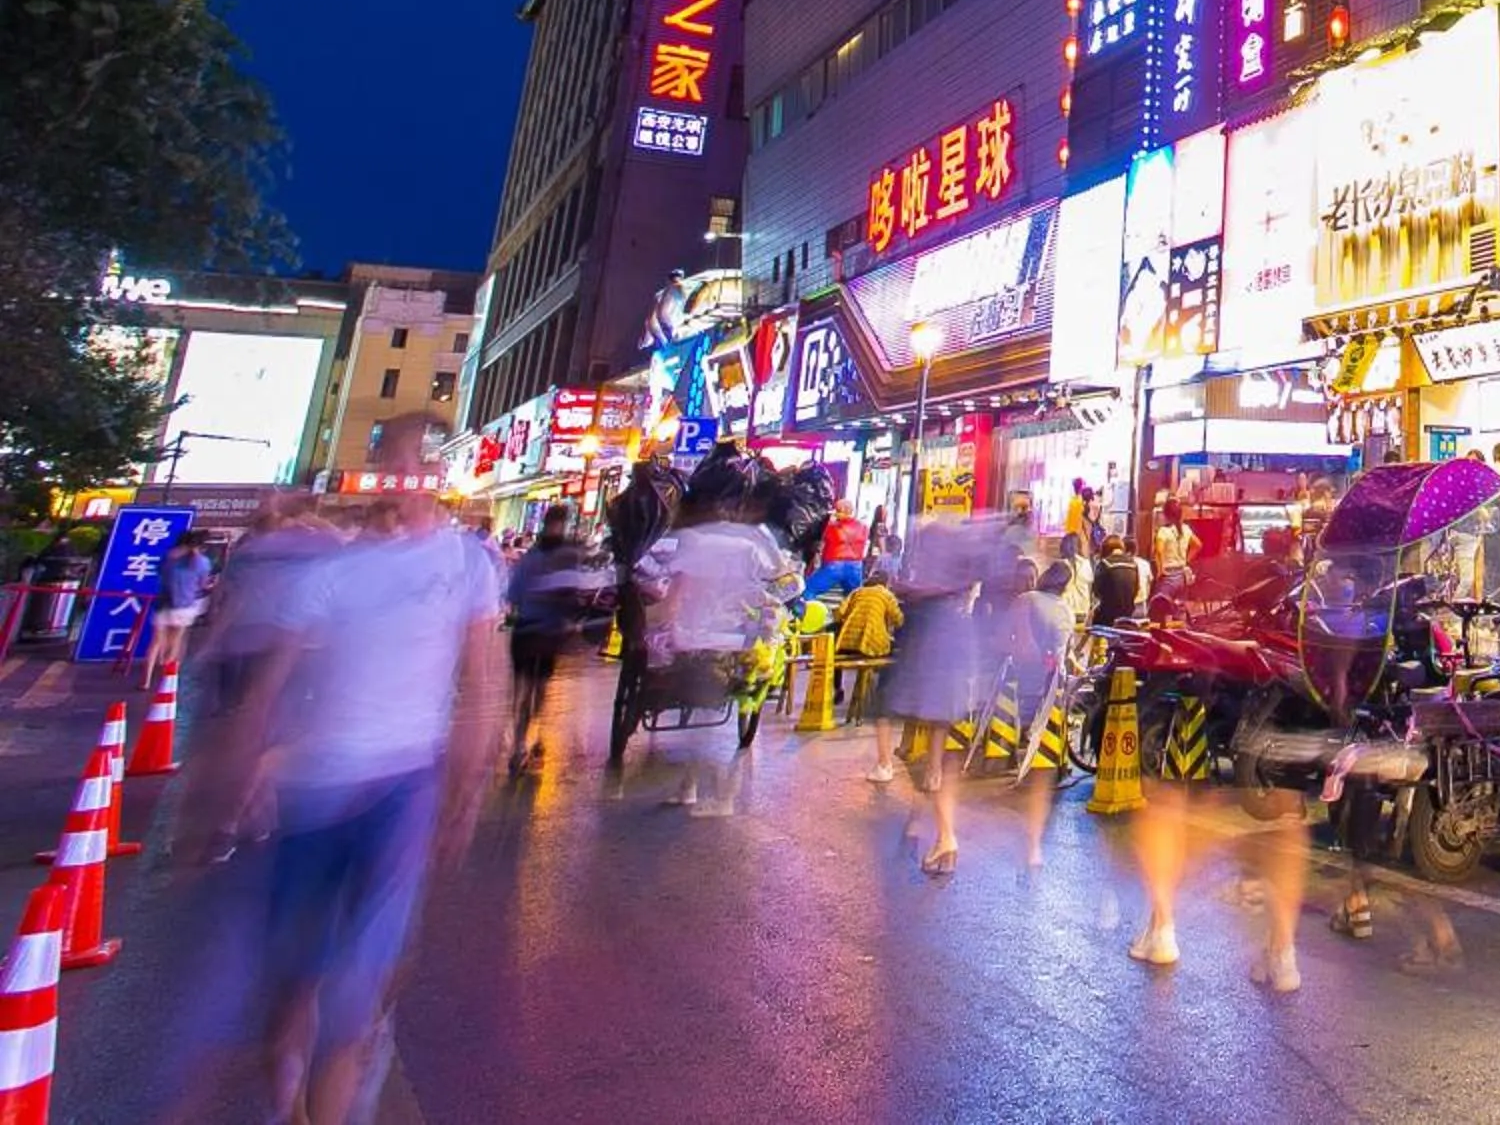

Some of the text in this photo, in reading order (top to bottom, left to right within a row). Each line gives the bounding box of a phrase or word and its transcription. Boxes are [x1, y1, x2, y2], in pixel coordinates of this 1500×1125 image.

[867, 97, 1013, 253] 哆啦星球
[678, 421, 700, 452] P
[103, 517, 174, 654] 停车入口
